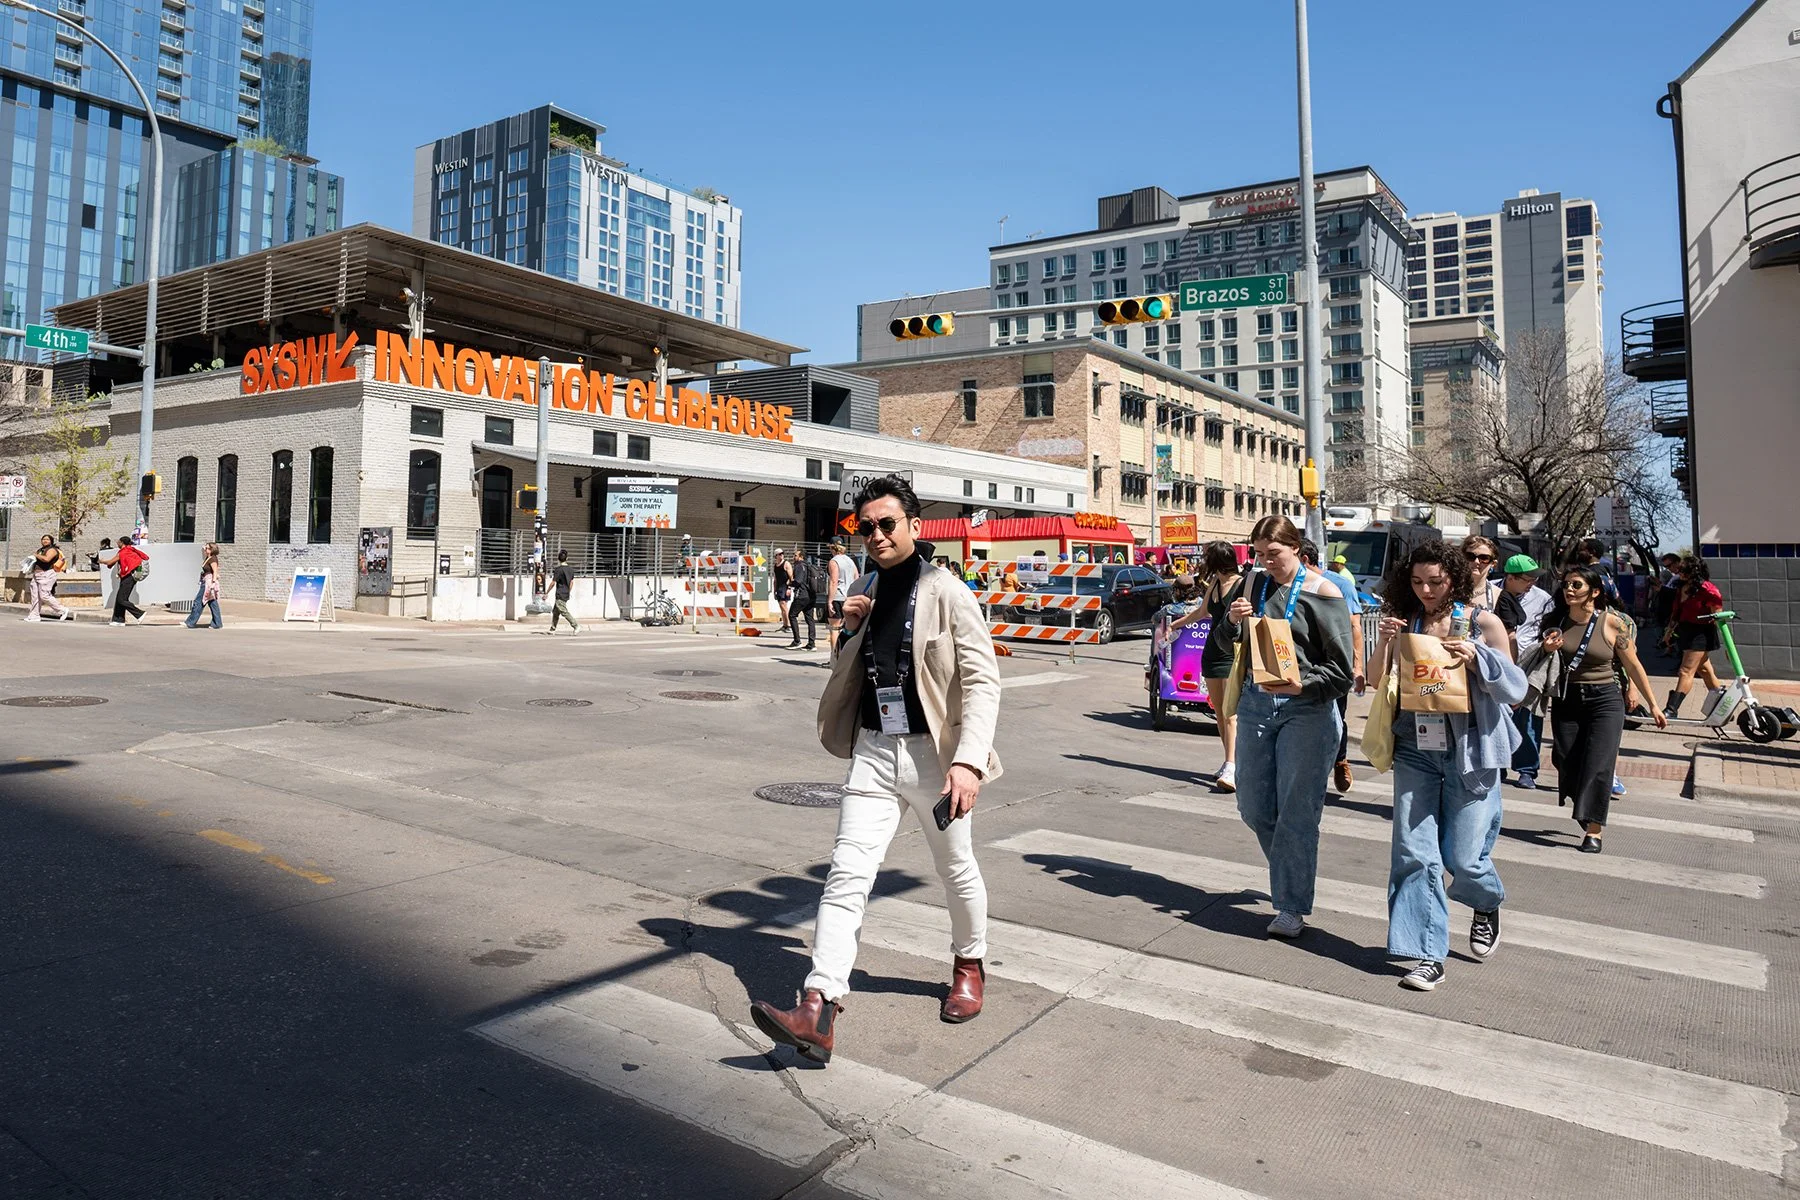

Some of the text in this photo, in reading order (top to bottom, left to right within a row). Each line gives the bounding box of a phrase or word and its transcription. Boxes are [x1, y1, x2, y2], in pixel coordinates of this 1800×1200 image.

[435, 157, 468, 175] WESTIN
[582, 157, 629, 188] WESTIN
[1215, 187, 1293, 208] Residence
[1511, 203, 1554, 216] Hilton
[1186, 278, 1283, 305] Brazos ST
[1260, 291, 1283, 302] 300
[42, 330, 68, 348] 4th
[241, 329, 793, 443] SXSW INNOVATION CLUBHOUSE
[1166, 526, 1193, 538] BM
[1274, 643, 1291, 656] BM
[1413, 664, 1451, 680] BM
